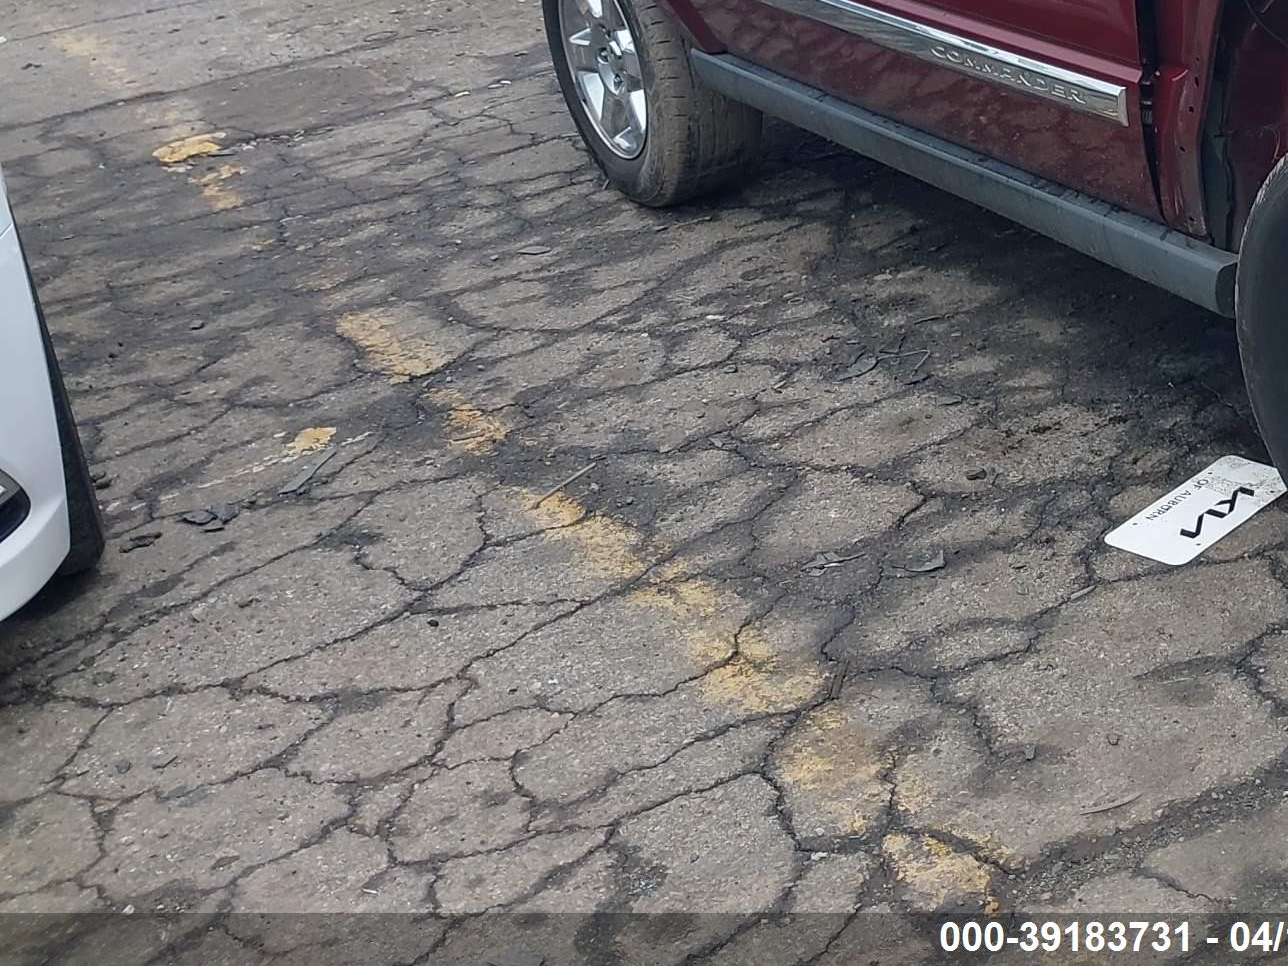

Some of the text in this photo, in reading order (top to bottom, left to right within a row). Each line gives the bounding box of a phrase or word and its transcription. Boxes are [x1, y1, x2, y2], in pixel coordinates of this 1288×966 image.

[930, 45, 1087, 105] COMMANDER
[1145, 478, 1209, 522] OF AUBURN
